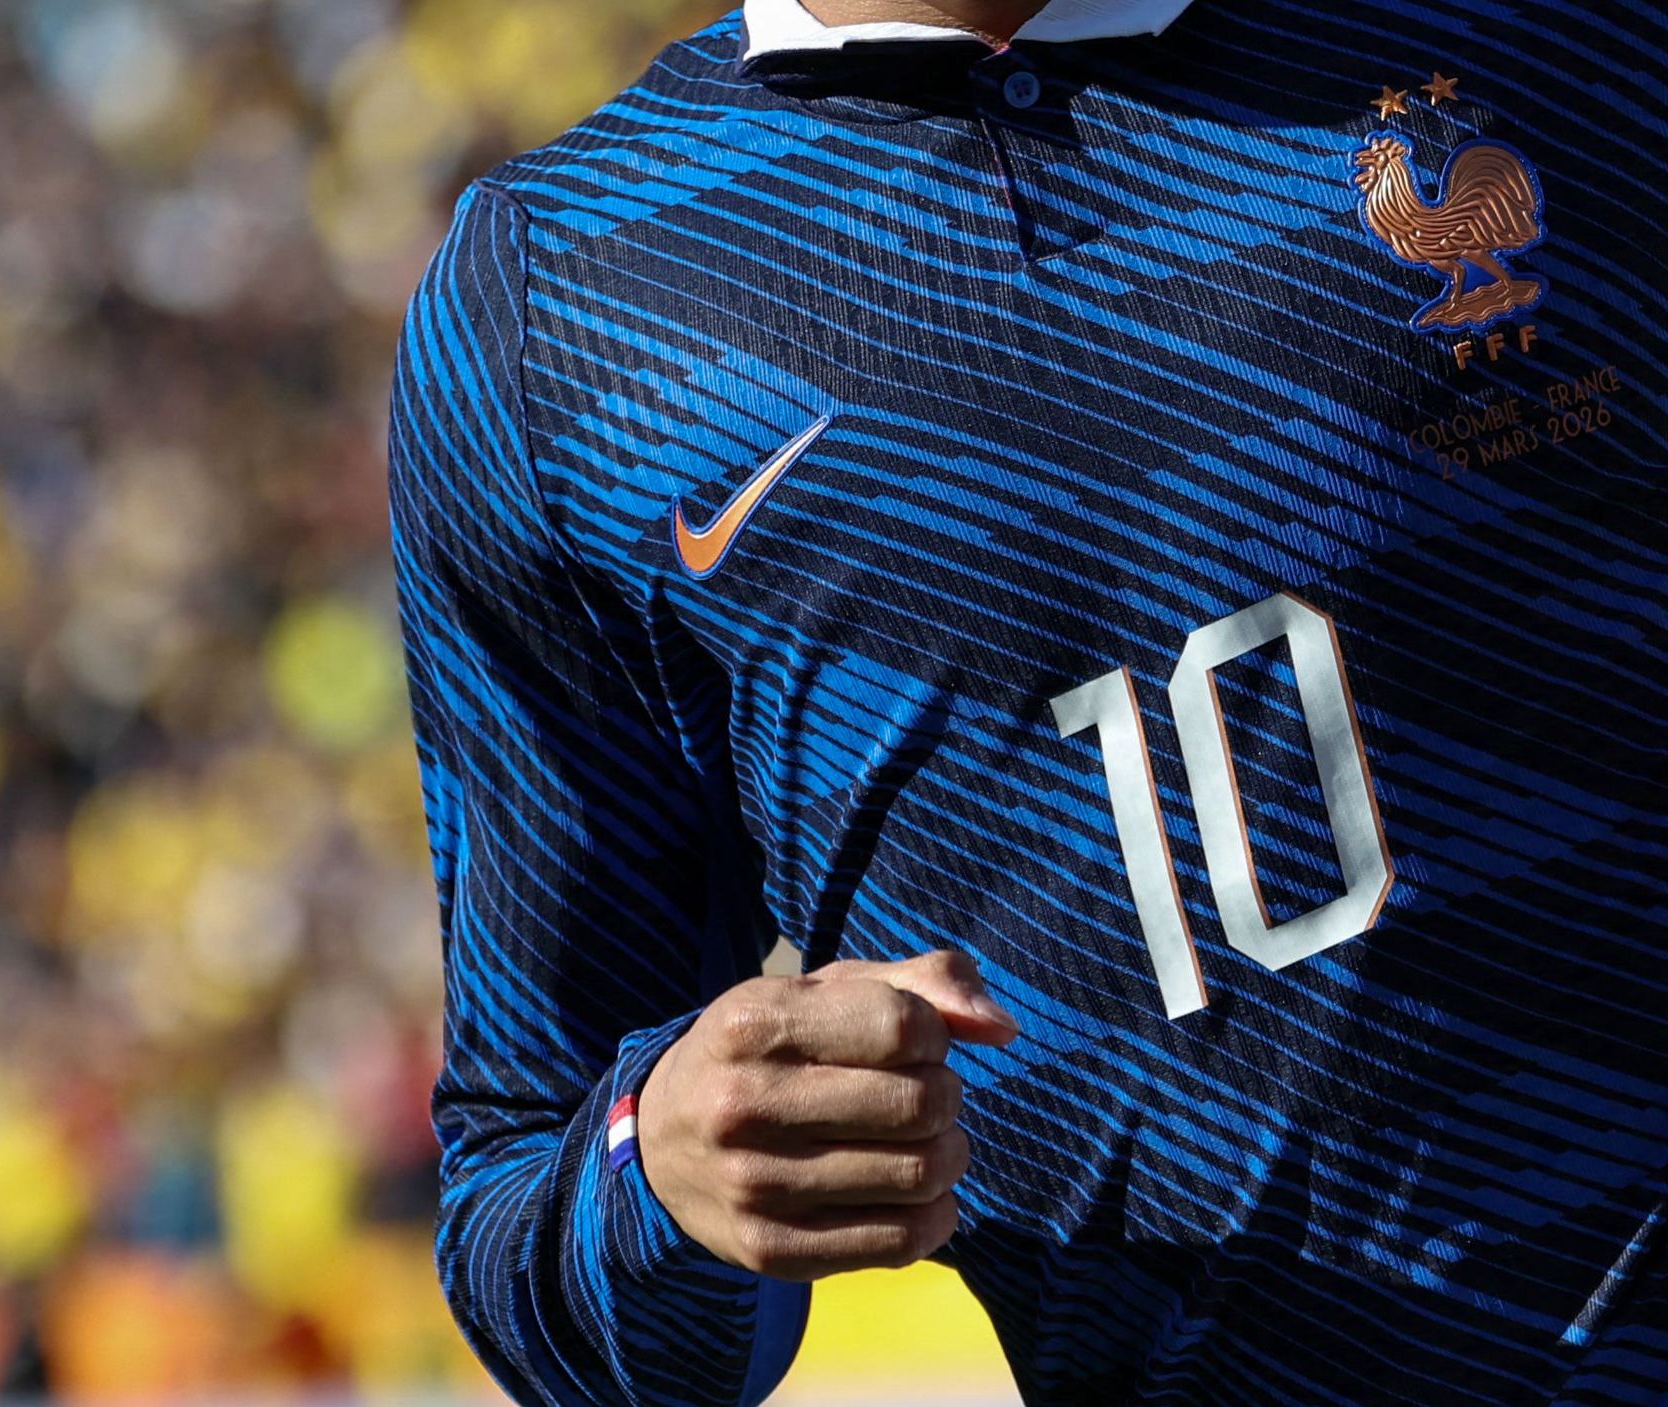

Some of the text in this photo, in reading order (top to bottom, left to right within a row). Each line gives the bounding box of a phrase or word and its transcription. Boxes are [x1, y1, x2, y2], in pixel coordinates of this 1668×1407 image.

[1453, 325, 1537, 370] FFF
[1409, 399, 1523, 453] COLOMBIE
[1547, 366, 1620, 411] FRANCE
[1436, 402, 1612, 480] 29 MARS 2026
[1049, 591, 1394, 1020] 10
